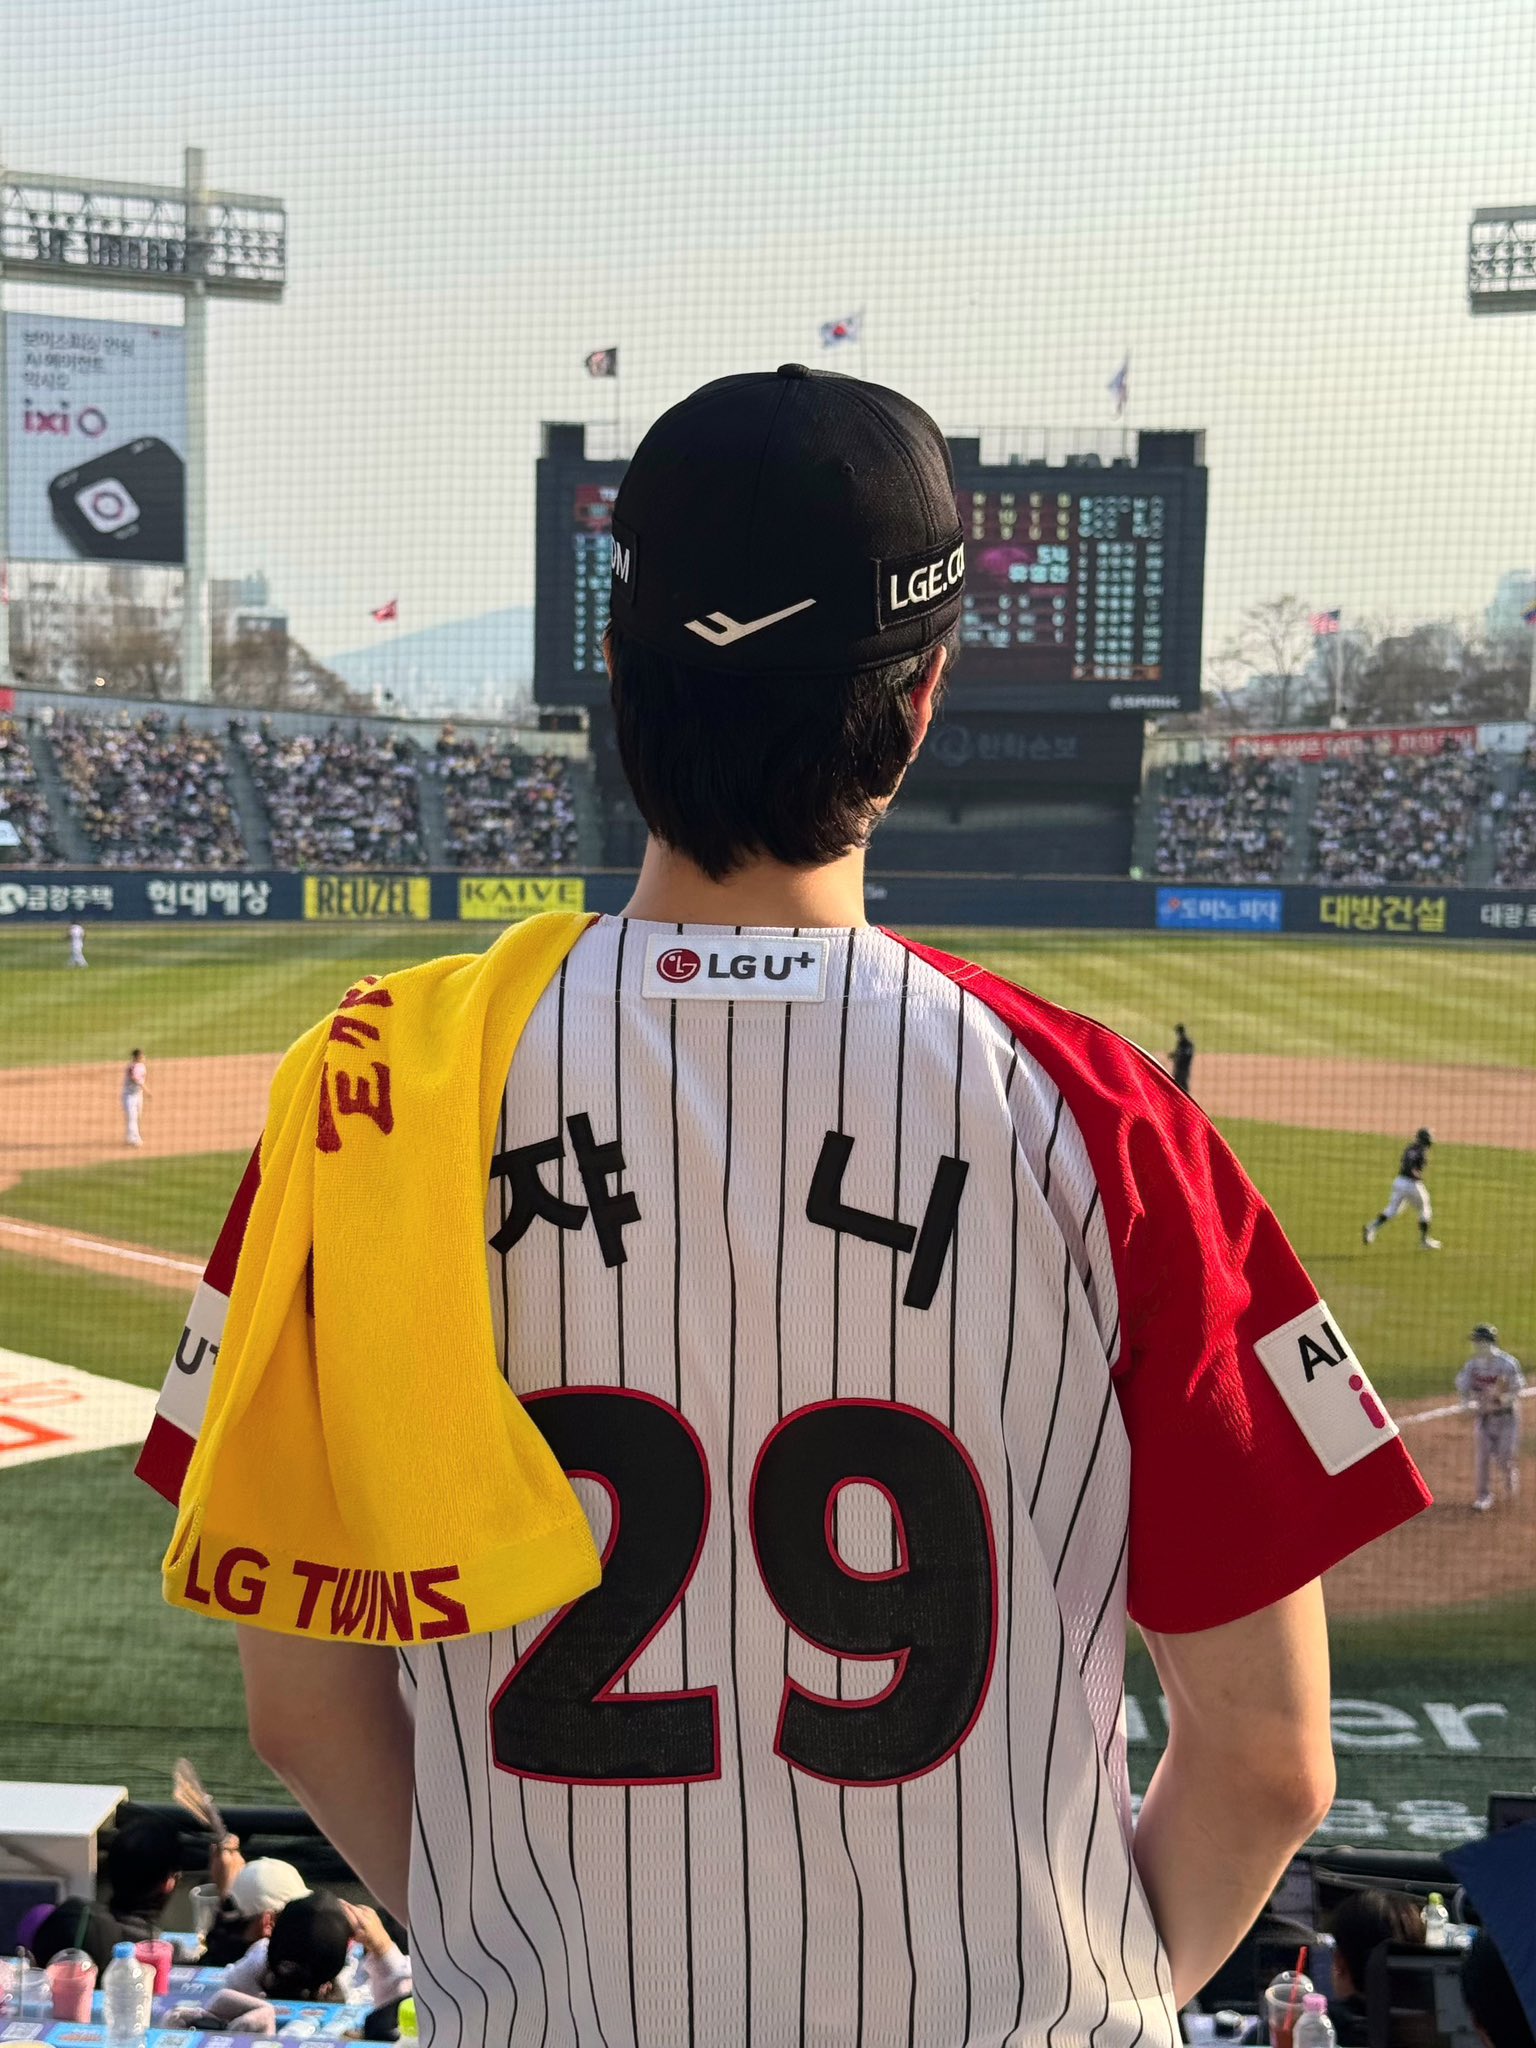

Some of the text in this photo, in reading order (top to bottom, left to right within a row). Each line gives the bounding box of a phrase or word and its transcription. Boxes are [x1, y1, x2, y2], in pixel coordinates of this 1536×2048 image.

[27, 884, 114, 911] 금강주택
[147, 879, 272, 916] 현대해상
[317, 878, 416, 916] REUZEL
[464, 881, 577, 905] KAIVE
[1319, 893, 1448, 934] 대방건설
[1297, 1321, 1348, 1383] AI
[184, 1535, 471, 1642] LG TWINS
[489, 1385, 999, 1788] 29
